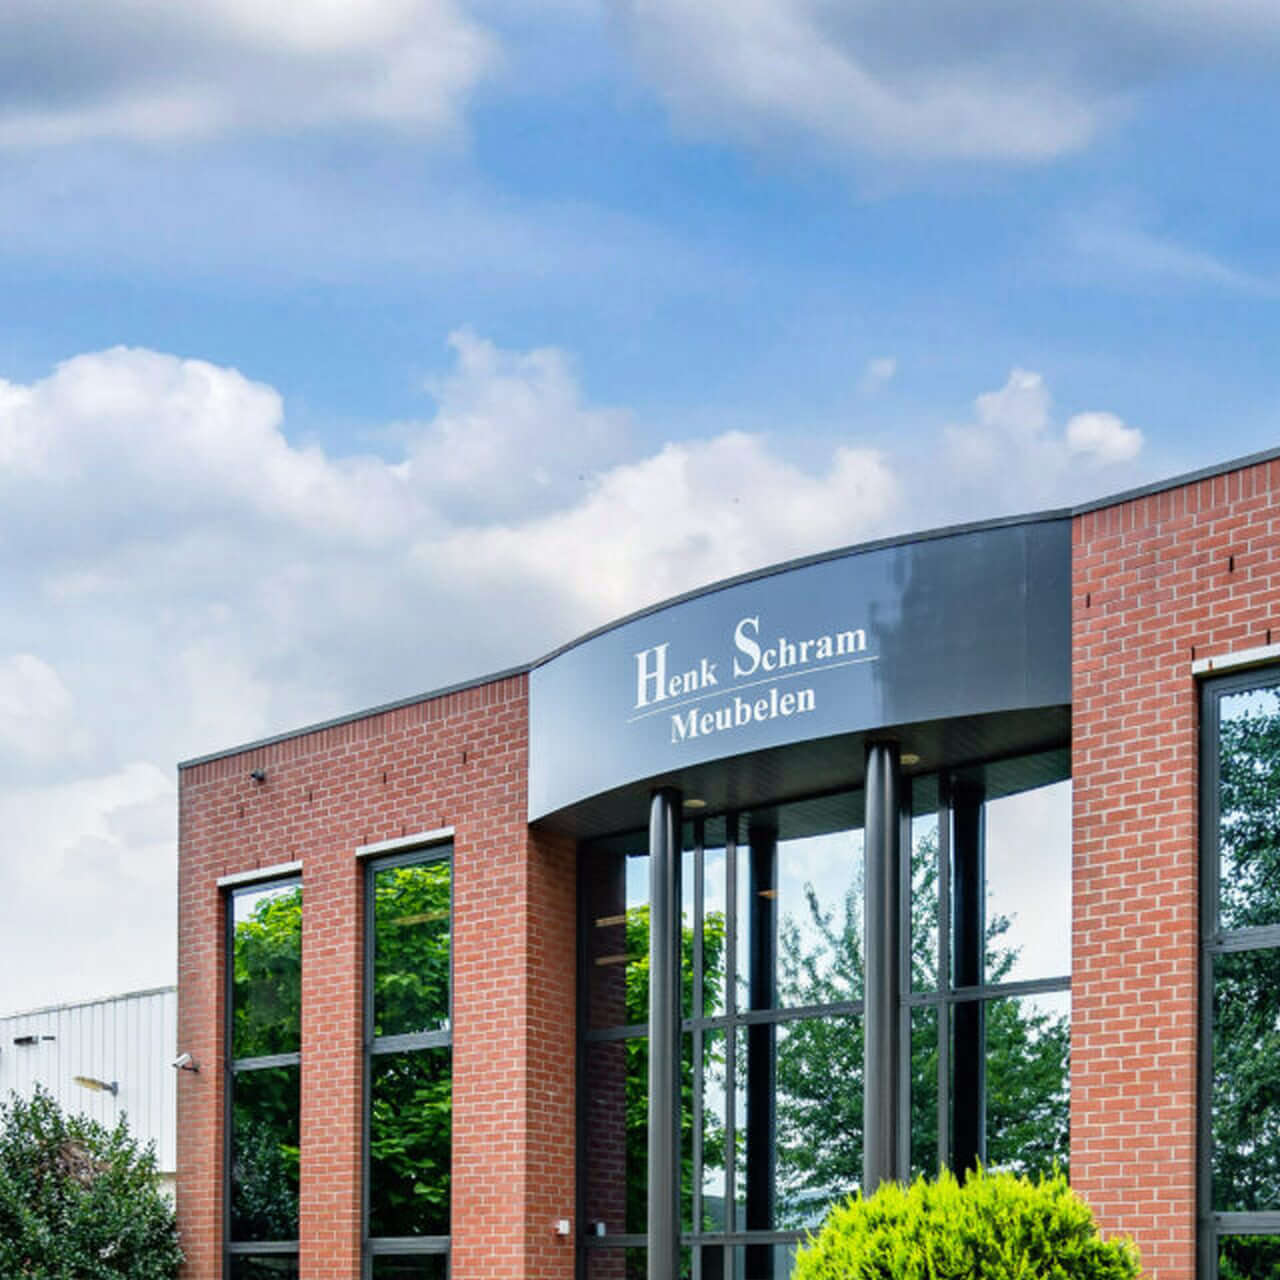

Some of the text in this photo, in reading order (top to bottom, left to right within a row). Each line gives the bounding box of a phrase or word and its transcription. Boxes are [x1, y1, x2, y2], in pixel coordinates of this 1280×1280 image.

[634, 616, 867, 709] Henk Schram
[671, 688, 816, 744] Meubelen
